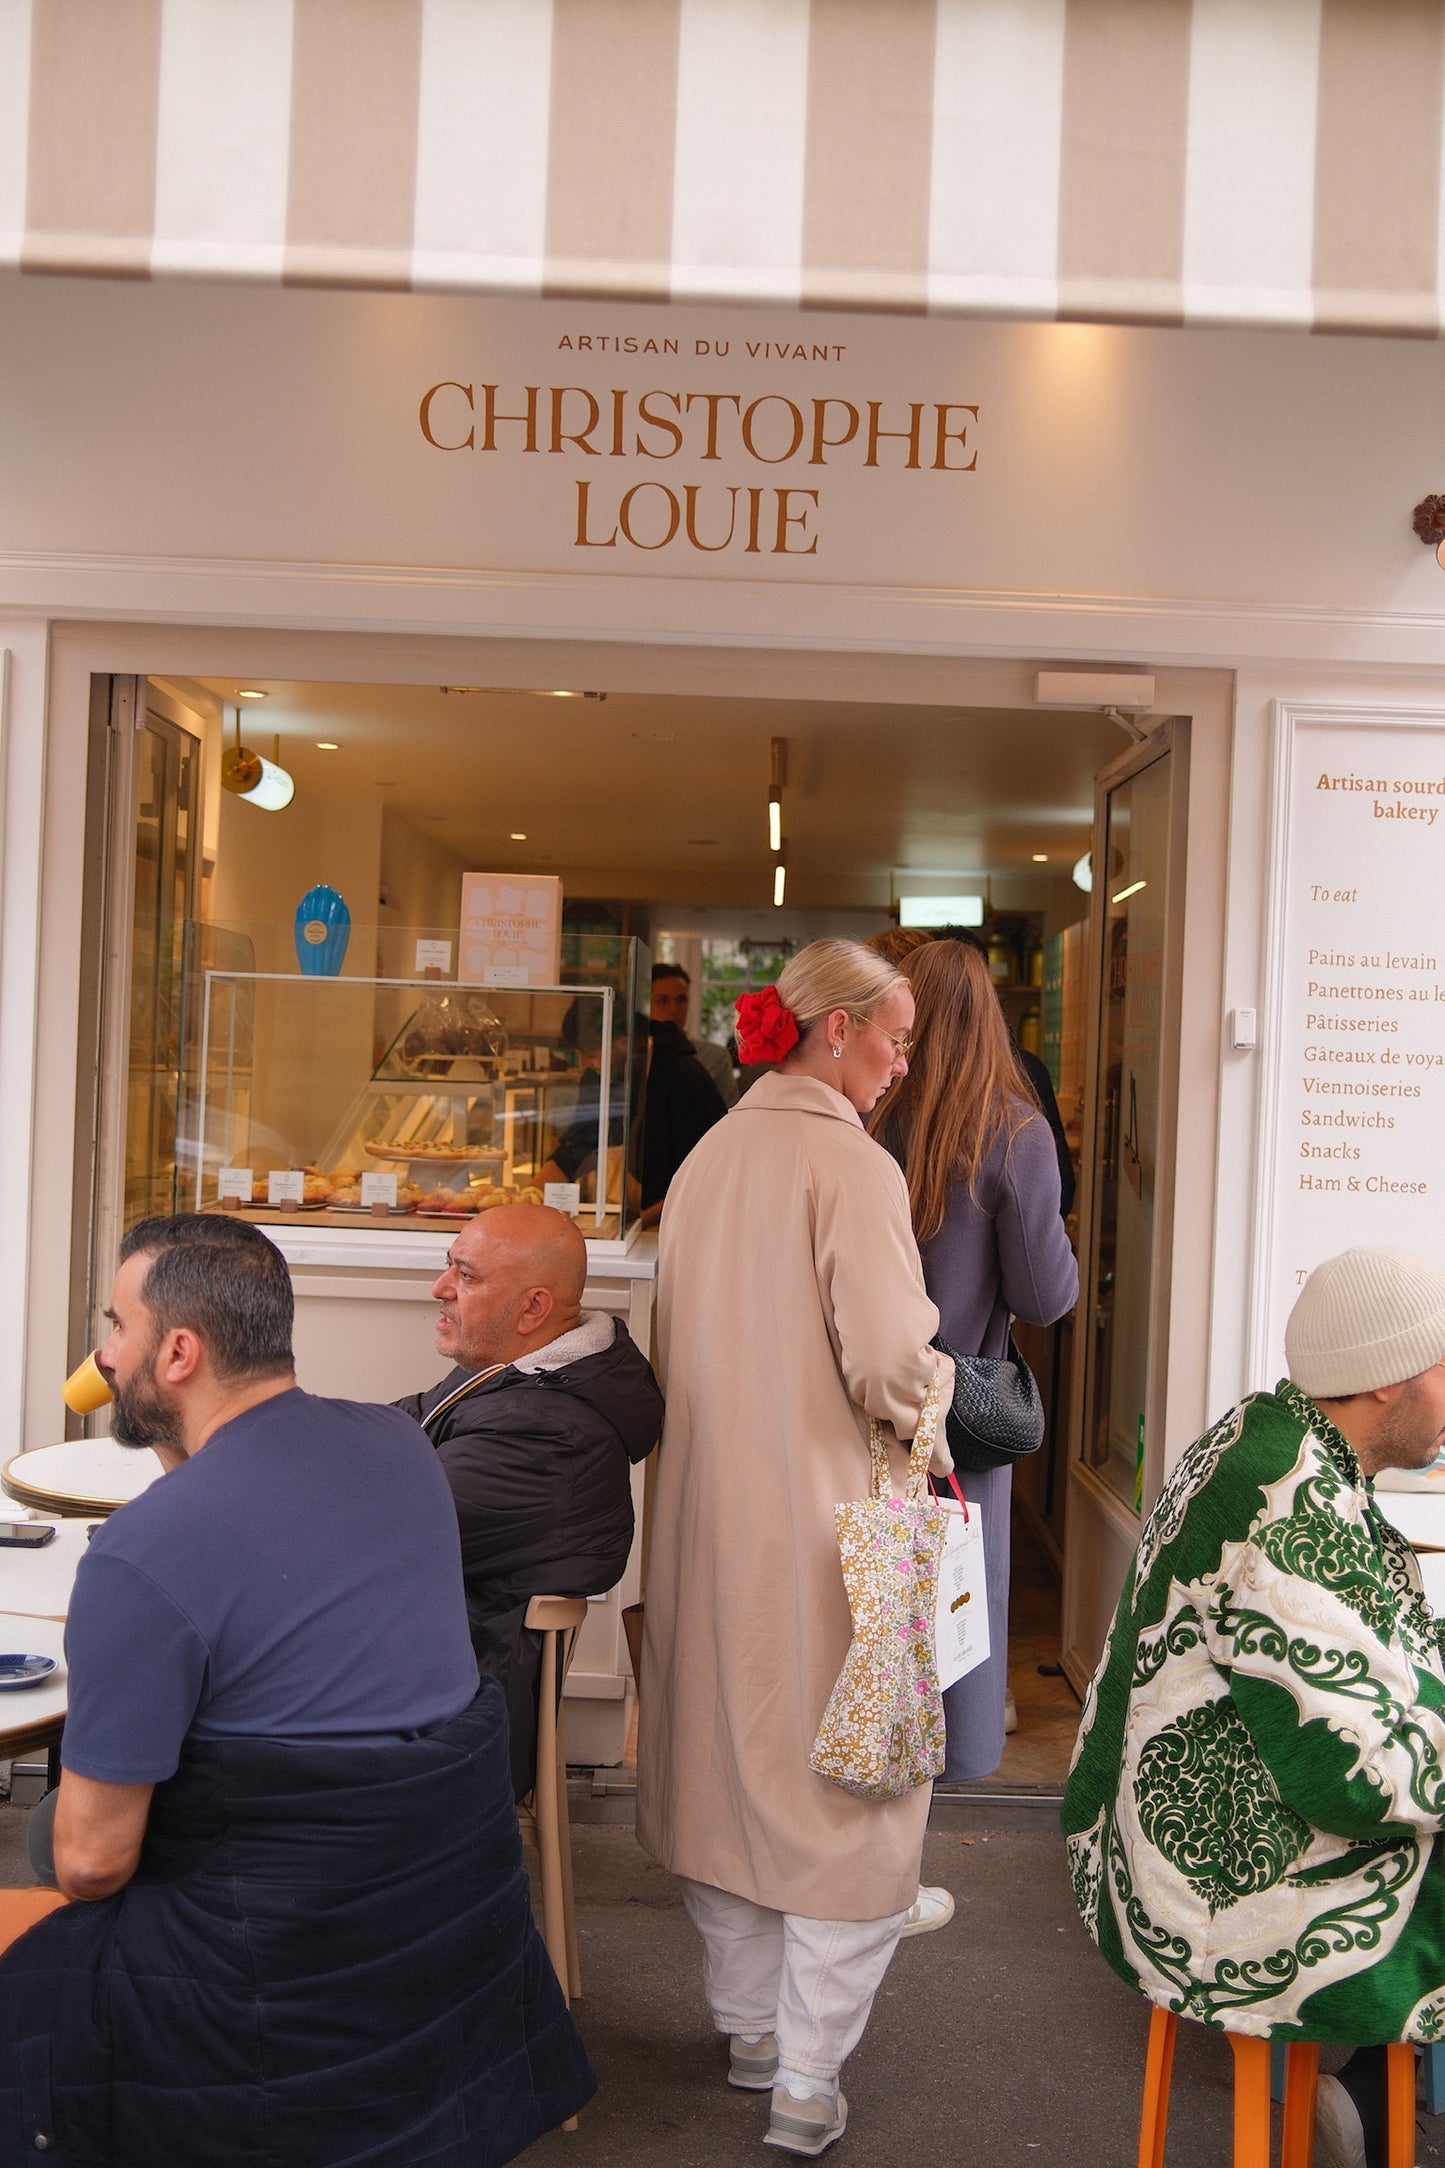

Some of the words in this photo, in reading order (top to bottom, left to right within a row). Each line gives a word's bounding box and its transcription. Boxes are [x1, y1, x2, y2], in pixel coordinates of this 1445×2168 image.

[558, 334, 679, 355] ARTISAN
[694, 340, 730, 358] DU
[744, 341, 847, 363] VIVANT
[418, 381, 980, 472] CHRISTOPHE
[573, 480, 820, 555] LOUIE
[1315, 772, 1389, 793] Artisan
[1392, 777, 1445, 795] sourd
[1373, 800, 1440, 826] bakery
[1310, 885, 1330, 902] To
[1333, 887, 1359, 903] eat
[1308, 948, 1356, 967] Pains
[1359, 954, 1381, 968] au
[1385, 951, 1437, 970] levain
[1307, 981, 1404, 1001] Panettones
[1408, 989, 1430, 1002] au
[1433, 984, 1445, 1002] le
[1305, 1014, 1398, 1033] Pâtisseries
[1303, 1045, 1376, 1065] Gâteaux
[1379, 1047, 1401, 1065] de
[1405, 1053, 1445, 1071] voya
[1302, 1077, 1421, 1097] Viennoiseries
[1300, 1109, 1395, 1129] Sandwichs
[1299, 1142, 1361, 1160] Snacks
[1299, 1174, 1342, 1191] Ham
[1346, 1175, 1362, 1192] &
[1365, 1175, 1428, 1194] Cheese
